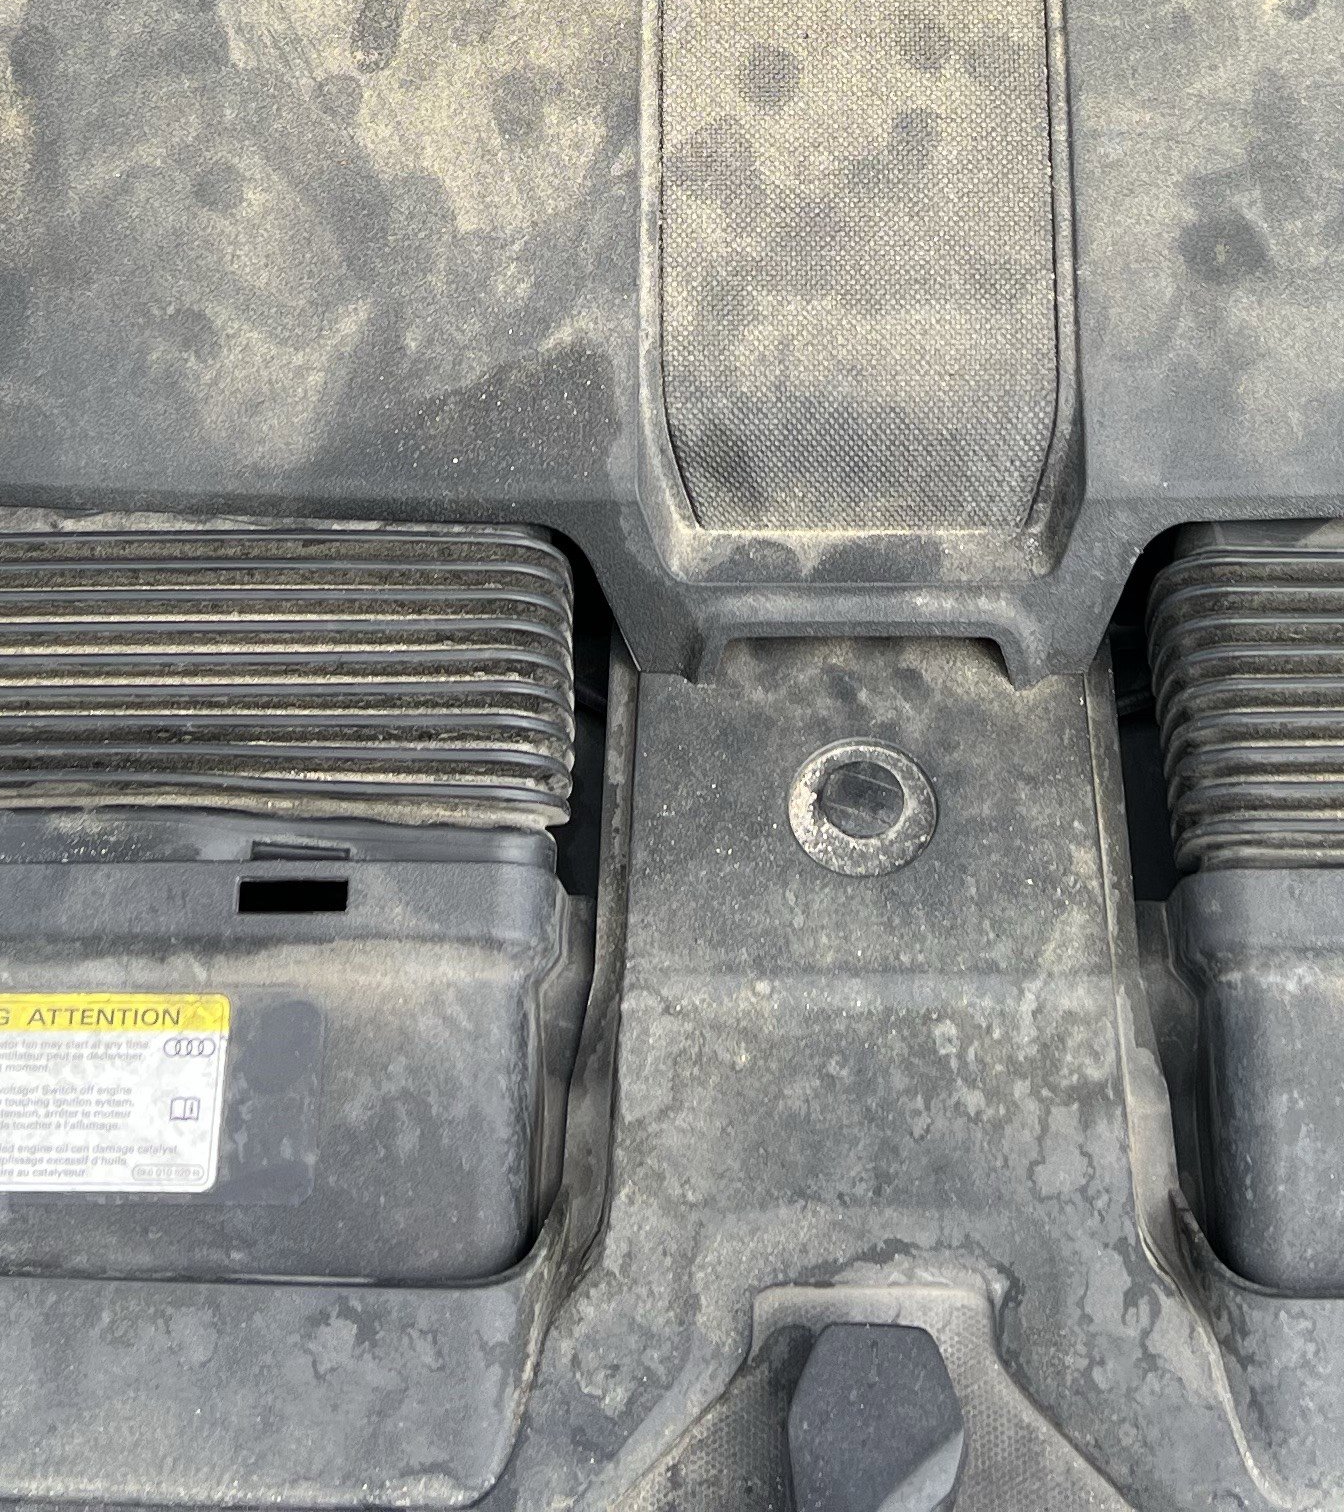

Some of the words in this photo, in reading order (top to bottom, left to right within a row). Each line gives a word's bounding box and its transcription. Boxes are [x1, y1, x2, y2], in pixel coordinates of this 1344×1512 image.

[27, 1007, 181, 1027] ATTENTION
[39, 1040, 64, 1051] may
[65, 1039, 88, 1050] start
[90, 1039, 103, 1050] at
[105, 1040, 123, 1051] any
[46, 1052, 69, 1062] peut
[71, 1053, 83, 1061] se
[41, 1086, 77, 1096] Switch
[79, 1086, 94, 1096] off
[96, 1086, 132, 1097] engine
[5, 1097, 49, 1109] touching
[81, 1109, 91, 1118] le
[93, 1110, 131, 1119] moteur
[13, 1120, 53, 1130] toucher
[17, 1144, 53, 1155] engine
[55, 1143, 69, 1154] oil
[71, 1145, 90, 1154] can
[92, 1143, 134, 1155] damage
[46, 1156, 88, 1165] excessif
[17, 1169, 30, 1177] au
